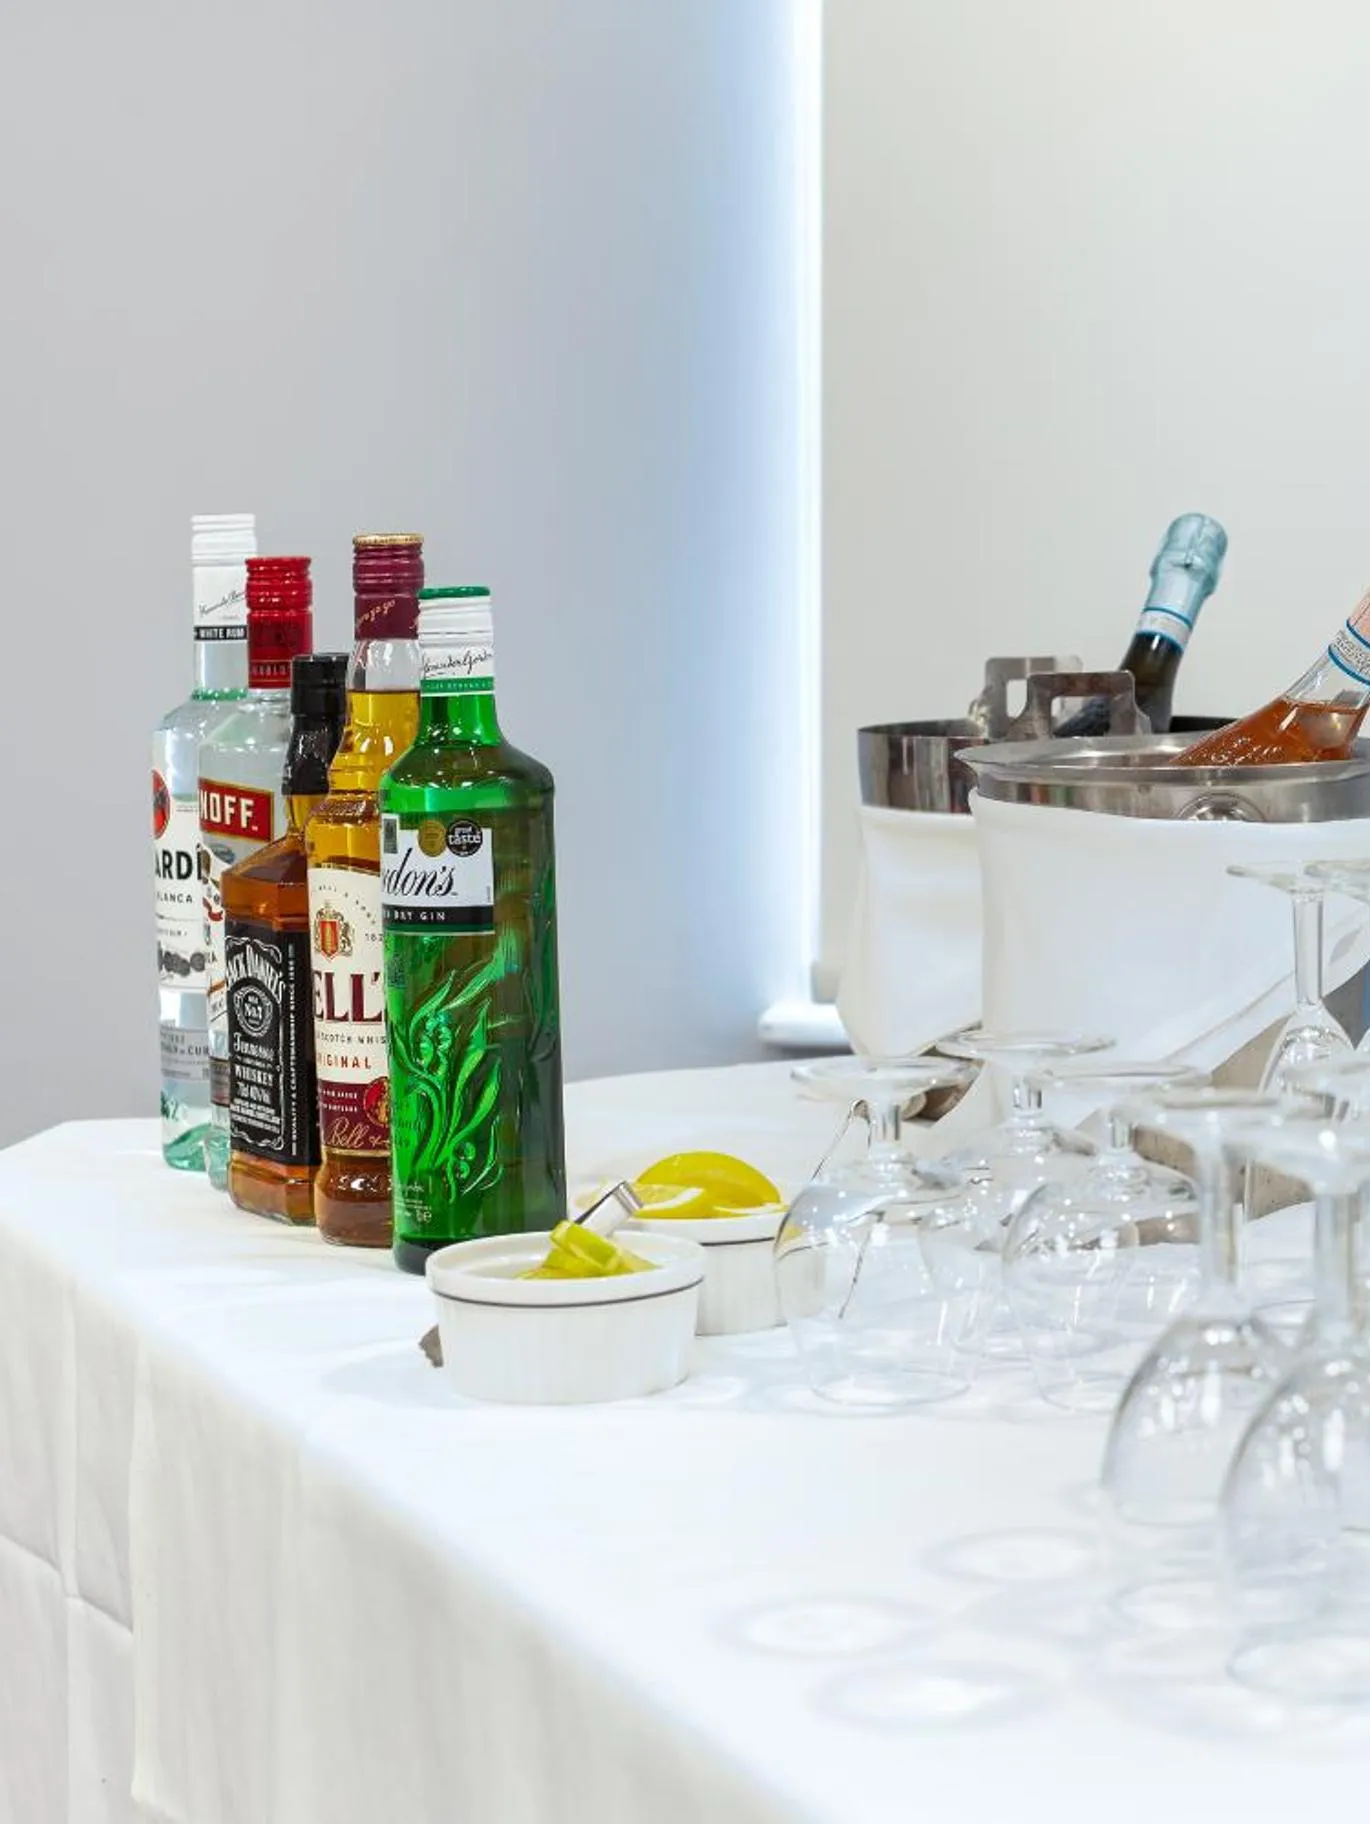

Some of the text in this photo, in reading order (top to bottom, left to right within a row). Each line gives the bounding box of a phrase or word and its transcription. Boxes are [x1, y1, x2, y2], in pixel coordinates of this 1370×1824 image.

[200, 627, 246, 639] WHITE RUM
[393, 910, 413, 921] DRY
[419, 911, 446, 921] GIN
[320, 1032, 352, 1045] SCOTCH
[327, 1116, 370, 1149] Bell
